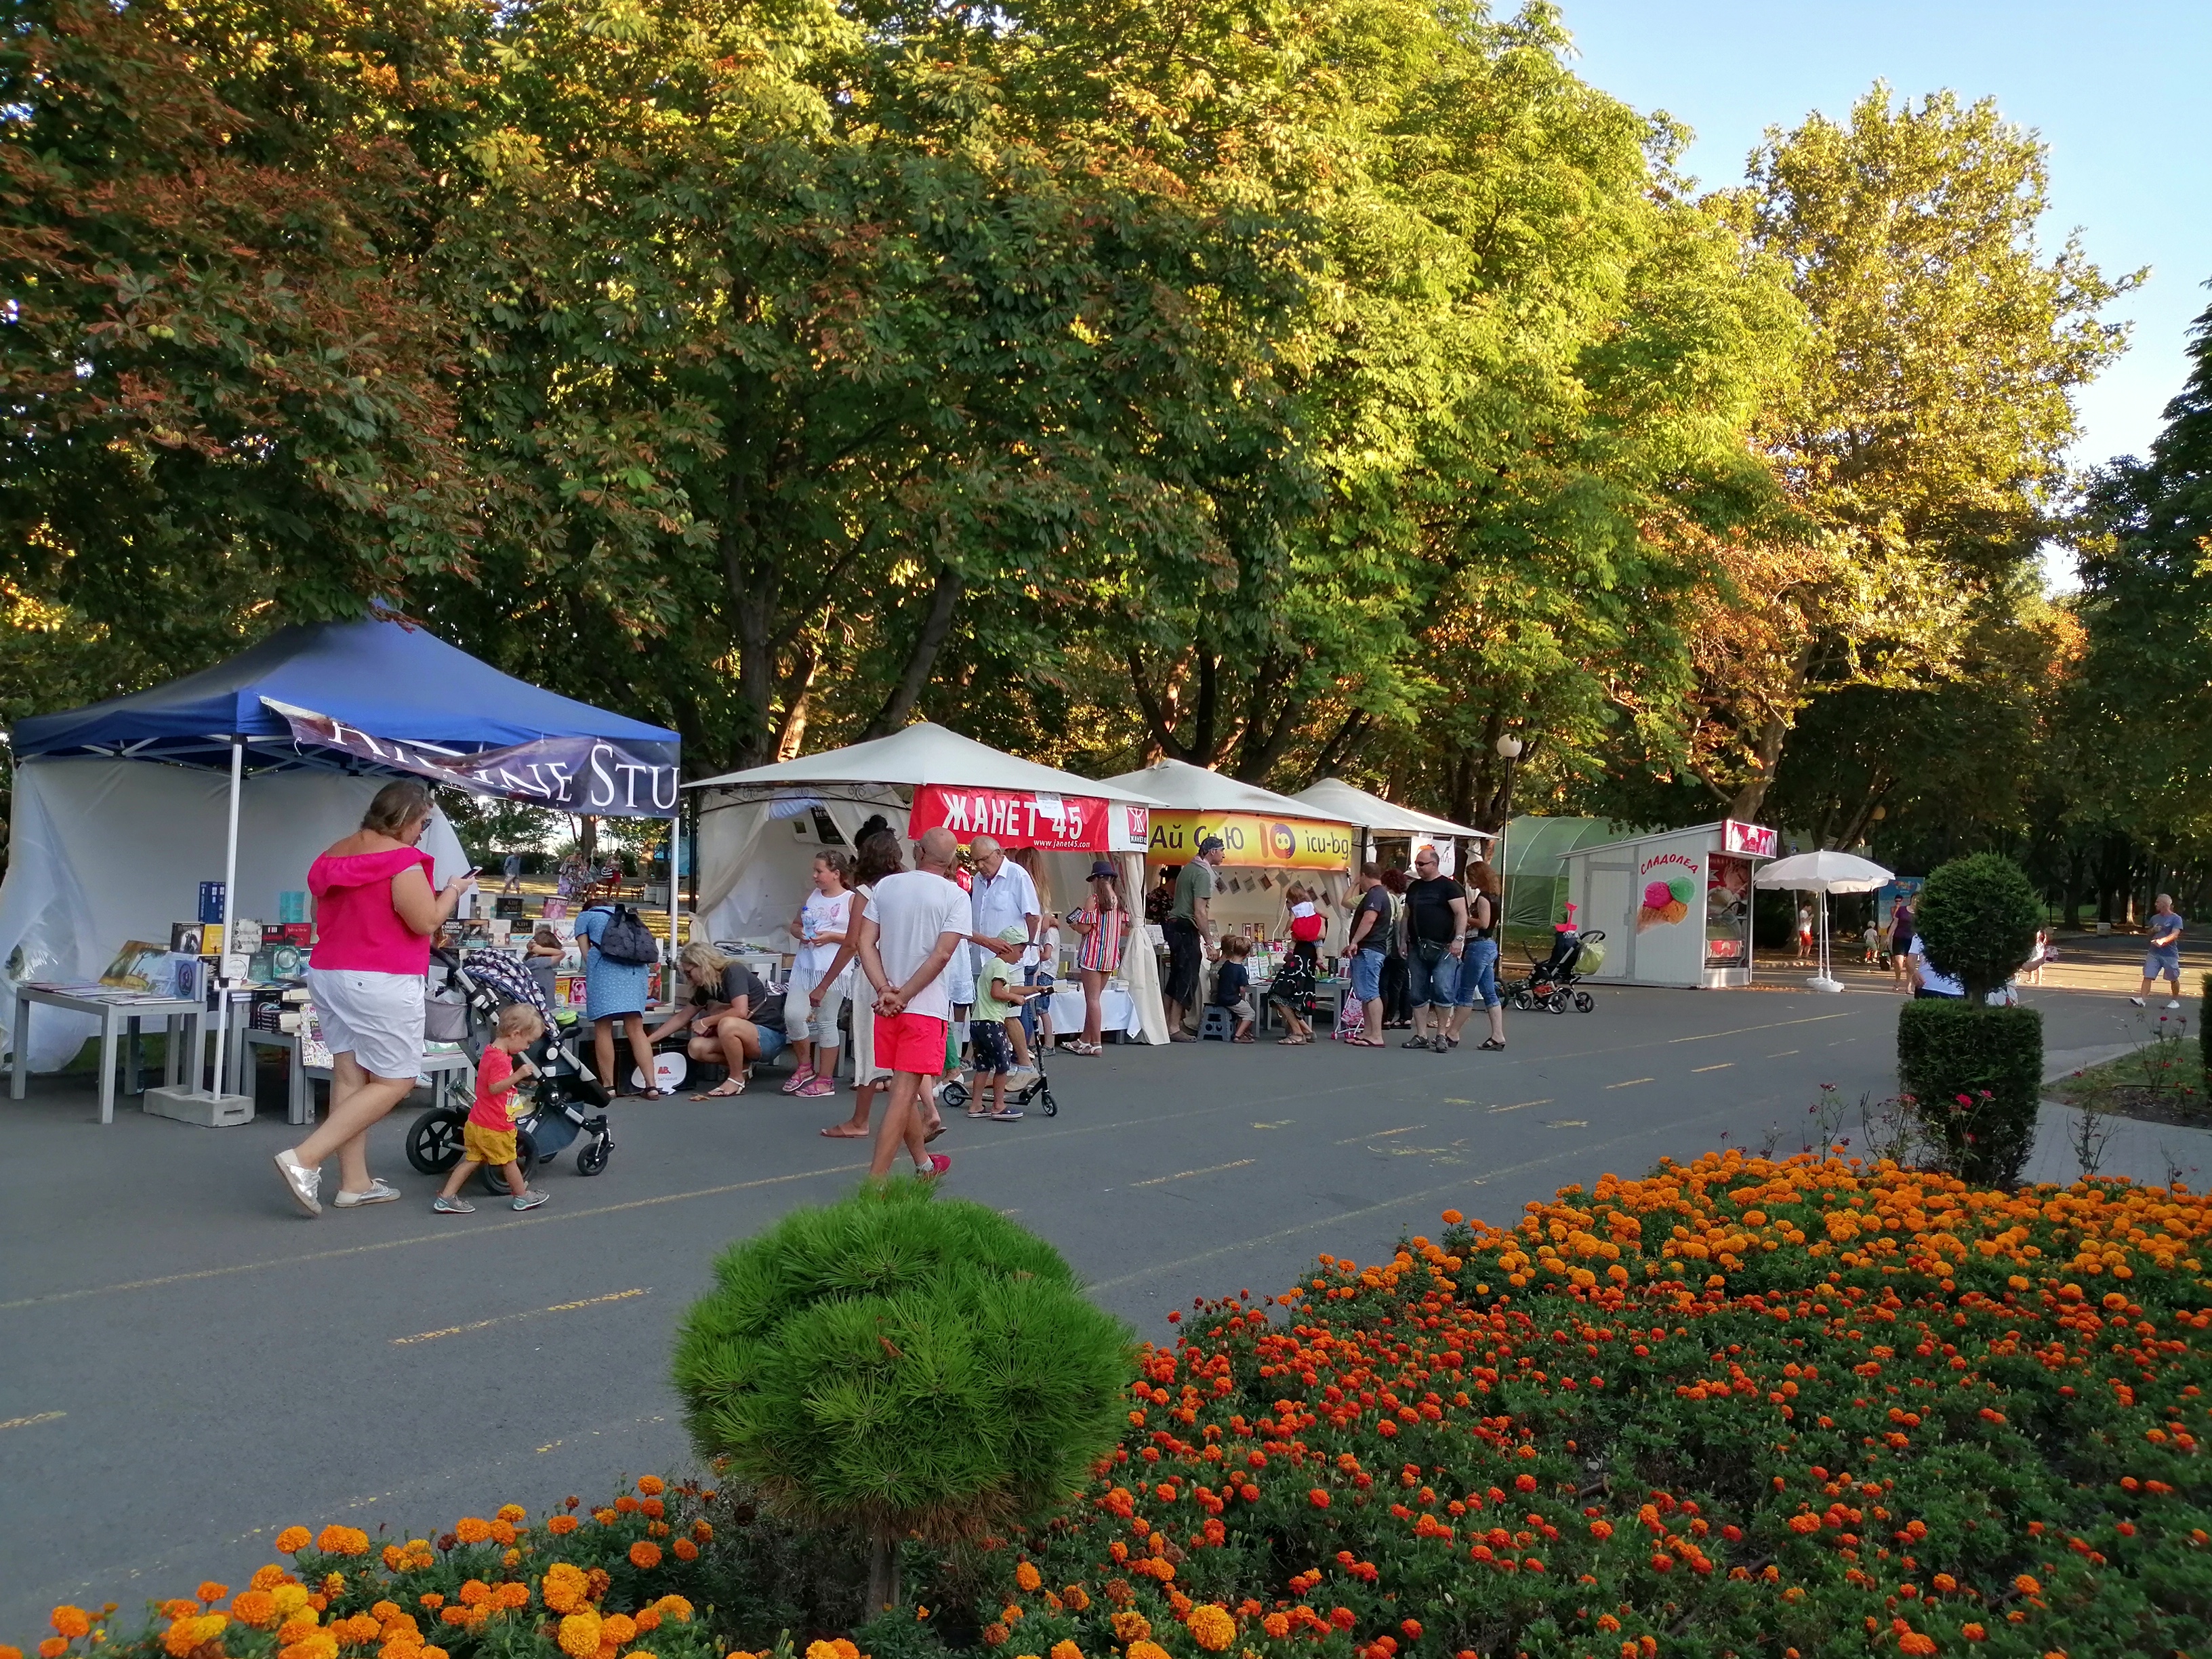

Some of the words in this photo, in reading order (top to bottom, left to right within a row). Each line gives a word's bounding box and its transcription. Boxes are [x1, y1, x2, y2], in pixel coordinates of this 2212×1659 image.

[942, 792, 1038, 837] ЖАНЕТ
[1051, 806, 1083, 840] 45
[1033, 839, 1090, 848] www.janet45.com
[1149, 824, 1183, 848] Ай
[1641, 853, 1699, 875] СЛАДОЛЕД
